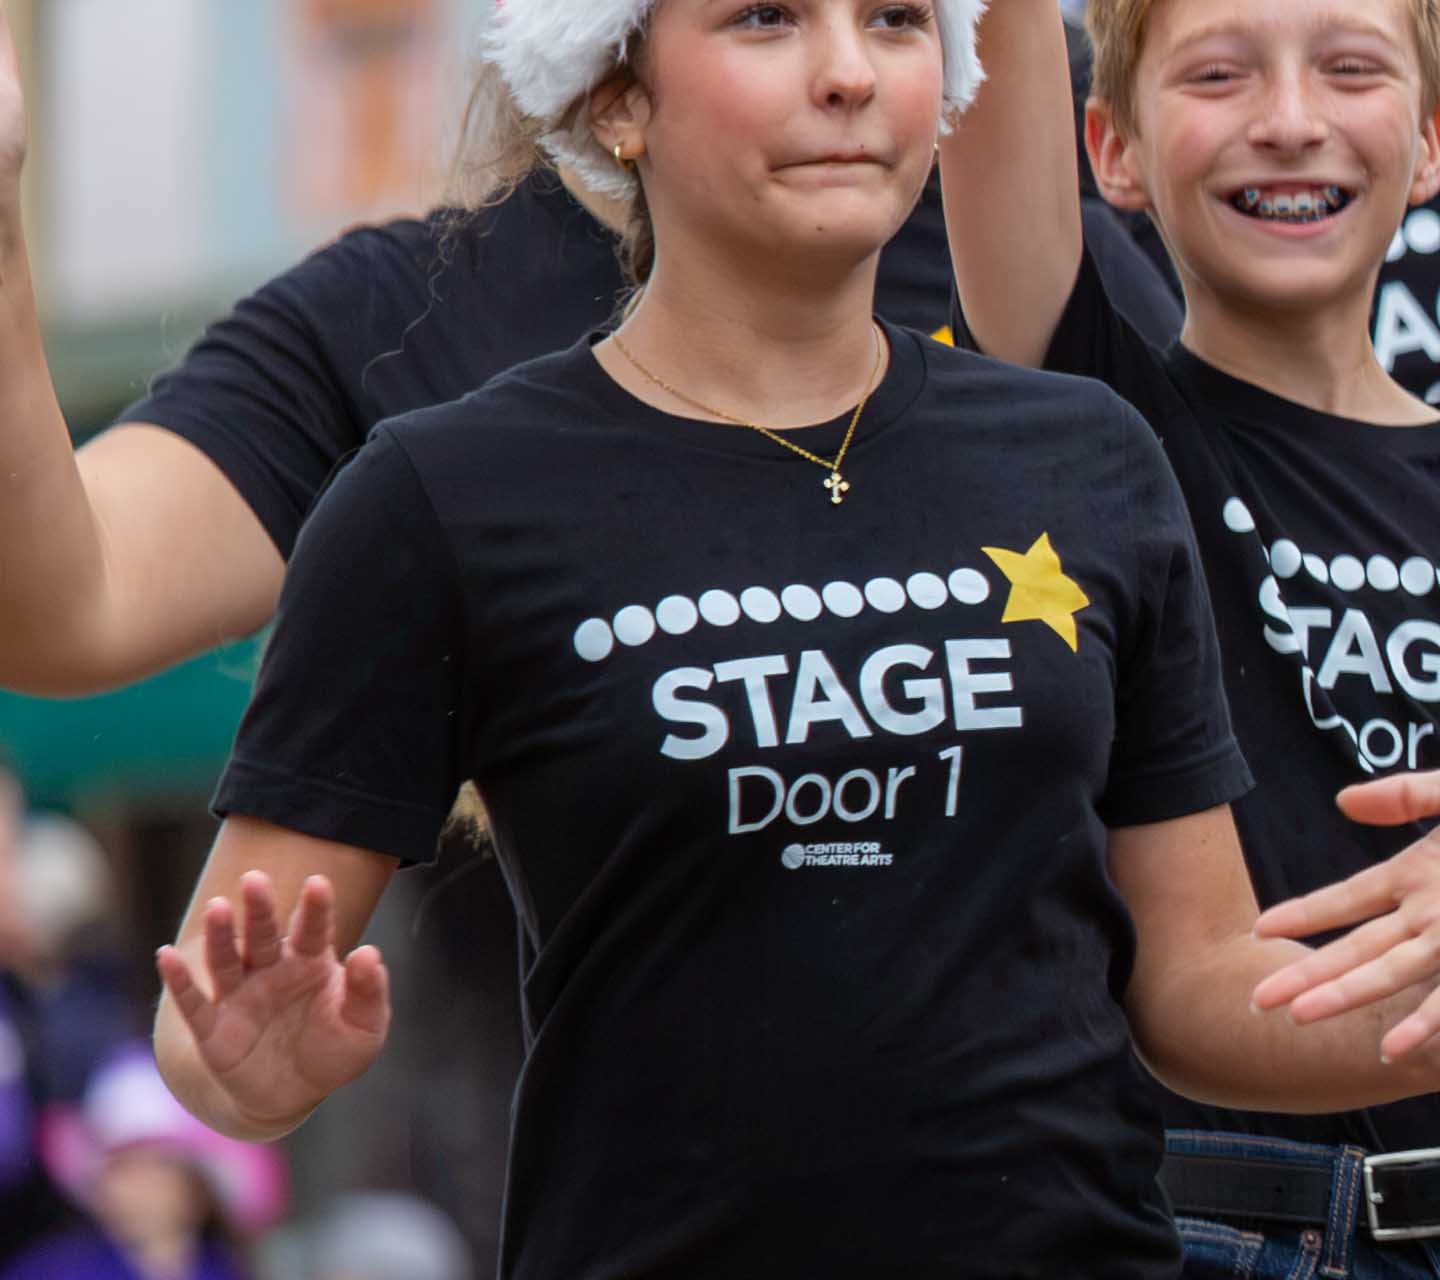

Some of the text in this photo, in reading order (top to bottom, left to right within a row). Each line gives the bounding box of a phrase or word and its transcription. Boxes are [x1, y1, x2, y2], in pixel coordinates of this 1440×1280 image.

[651, 637, 1023, 761] STAGE
[727, 745, 964, 836] Door 1
[805, 842, 881, 854] CENTER FOR
[805, 853, 893, 866] THEATRE ARTS
